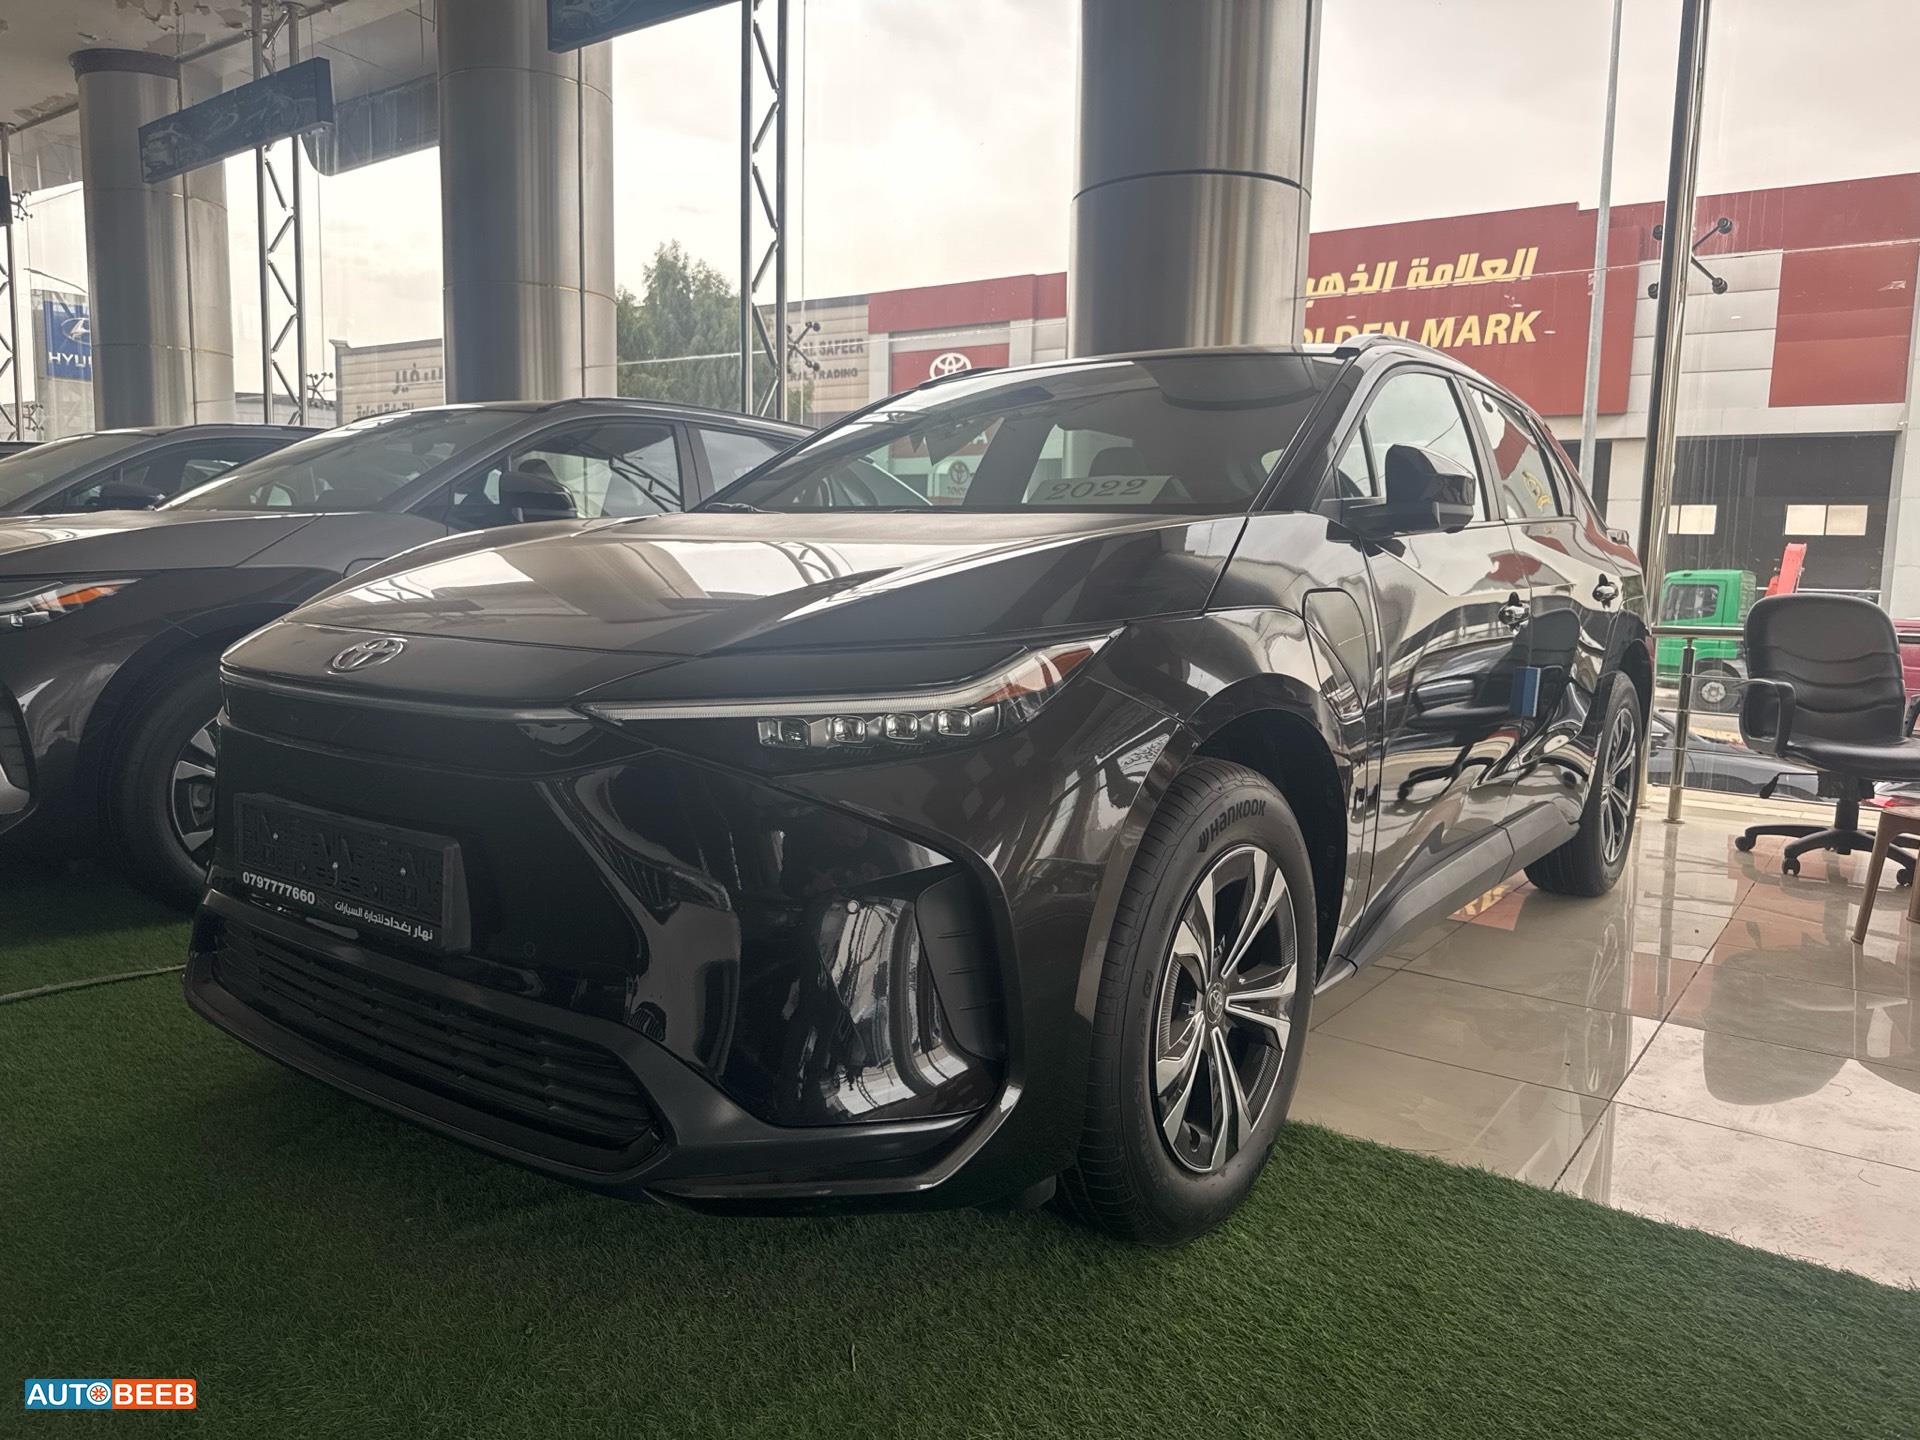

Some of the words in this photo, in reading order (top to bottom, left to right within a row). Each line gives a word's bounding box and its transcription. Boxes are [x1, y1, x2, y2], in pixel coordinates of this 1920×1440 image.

[1406, 247, 1539, 291] العلامة
[1419, 310, 1543, 348] MARK
[1045, 478, 1147, 500] 2022
[242, 871, 315, 904] 0797777660
